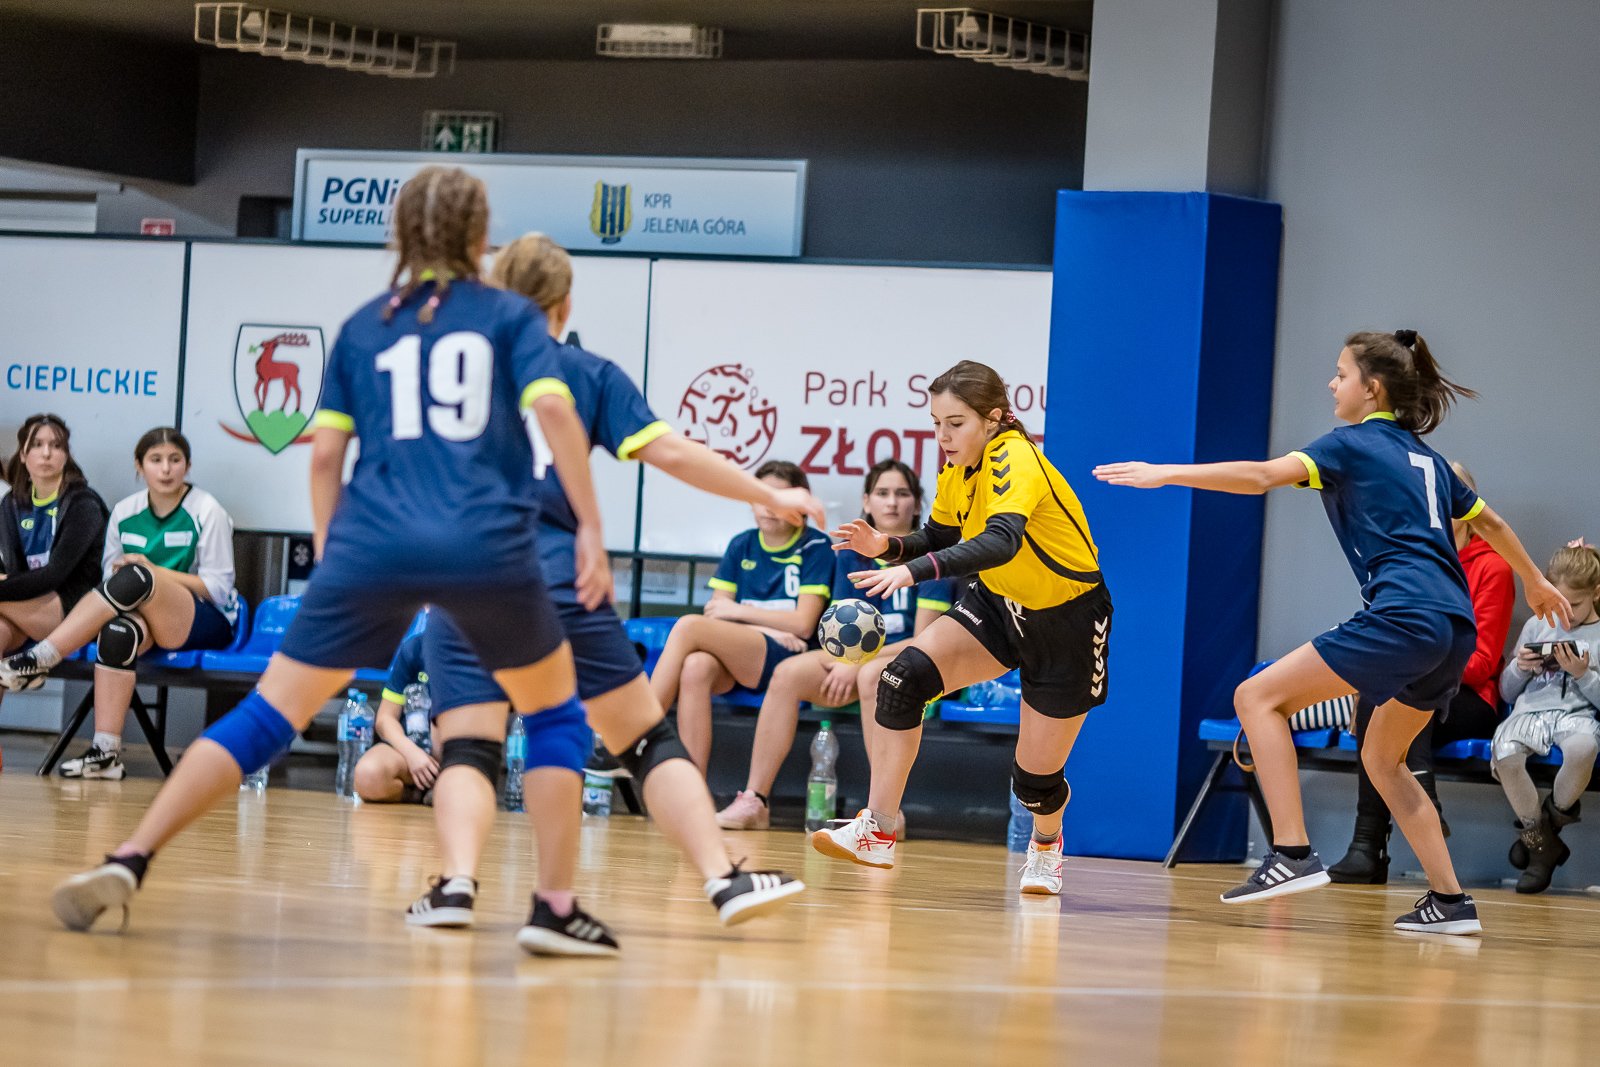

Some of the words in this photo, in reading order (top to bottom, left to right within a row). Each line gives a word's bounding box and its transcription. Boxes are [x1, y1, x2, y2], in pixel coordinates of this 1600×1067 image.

[322, 177, 400, 205] PGNi
[643, 193, 672, 209] KPR
[318, 207, 393, 225] SUPERL
[642, 217, 700, 234] JELENIA
[703, 216, 747, 236] GÓRA
[6, 364, 158, 397] CIEPLICKIE
[375, 331, 495, 443] 19
[804, 370, 887, 408] Park
[798, 425, 947, 480] ZŁOT
[1408, 452, 1443, 529] 7
[784, 564, 800, 598] 6
[954, 603, 983, 626] hummel
[881, 670, 903, 686] SELECT
